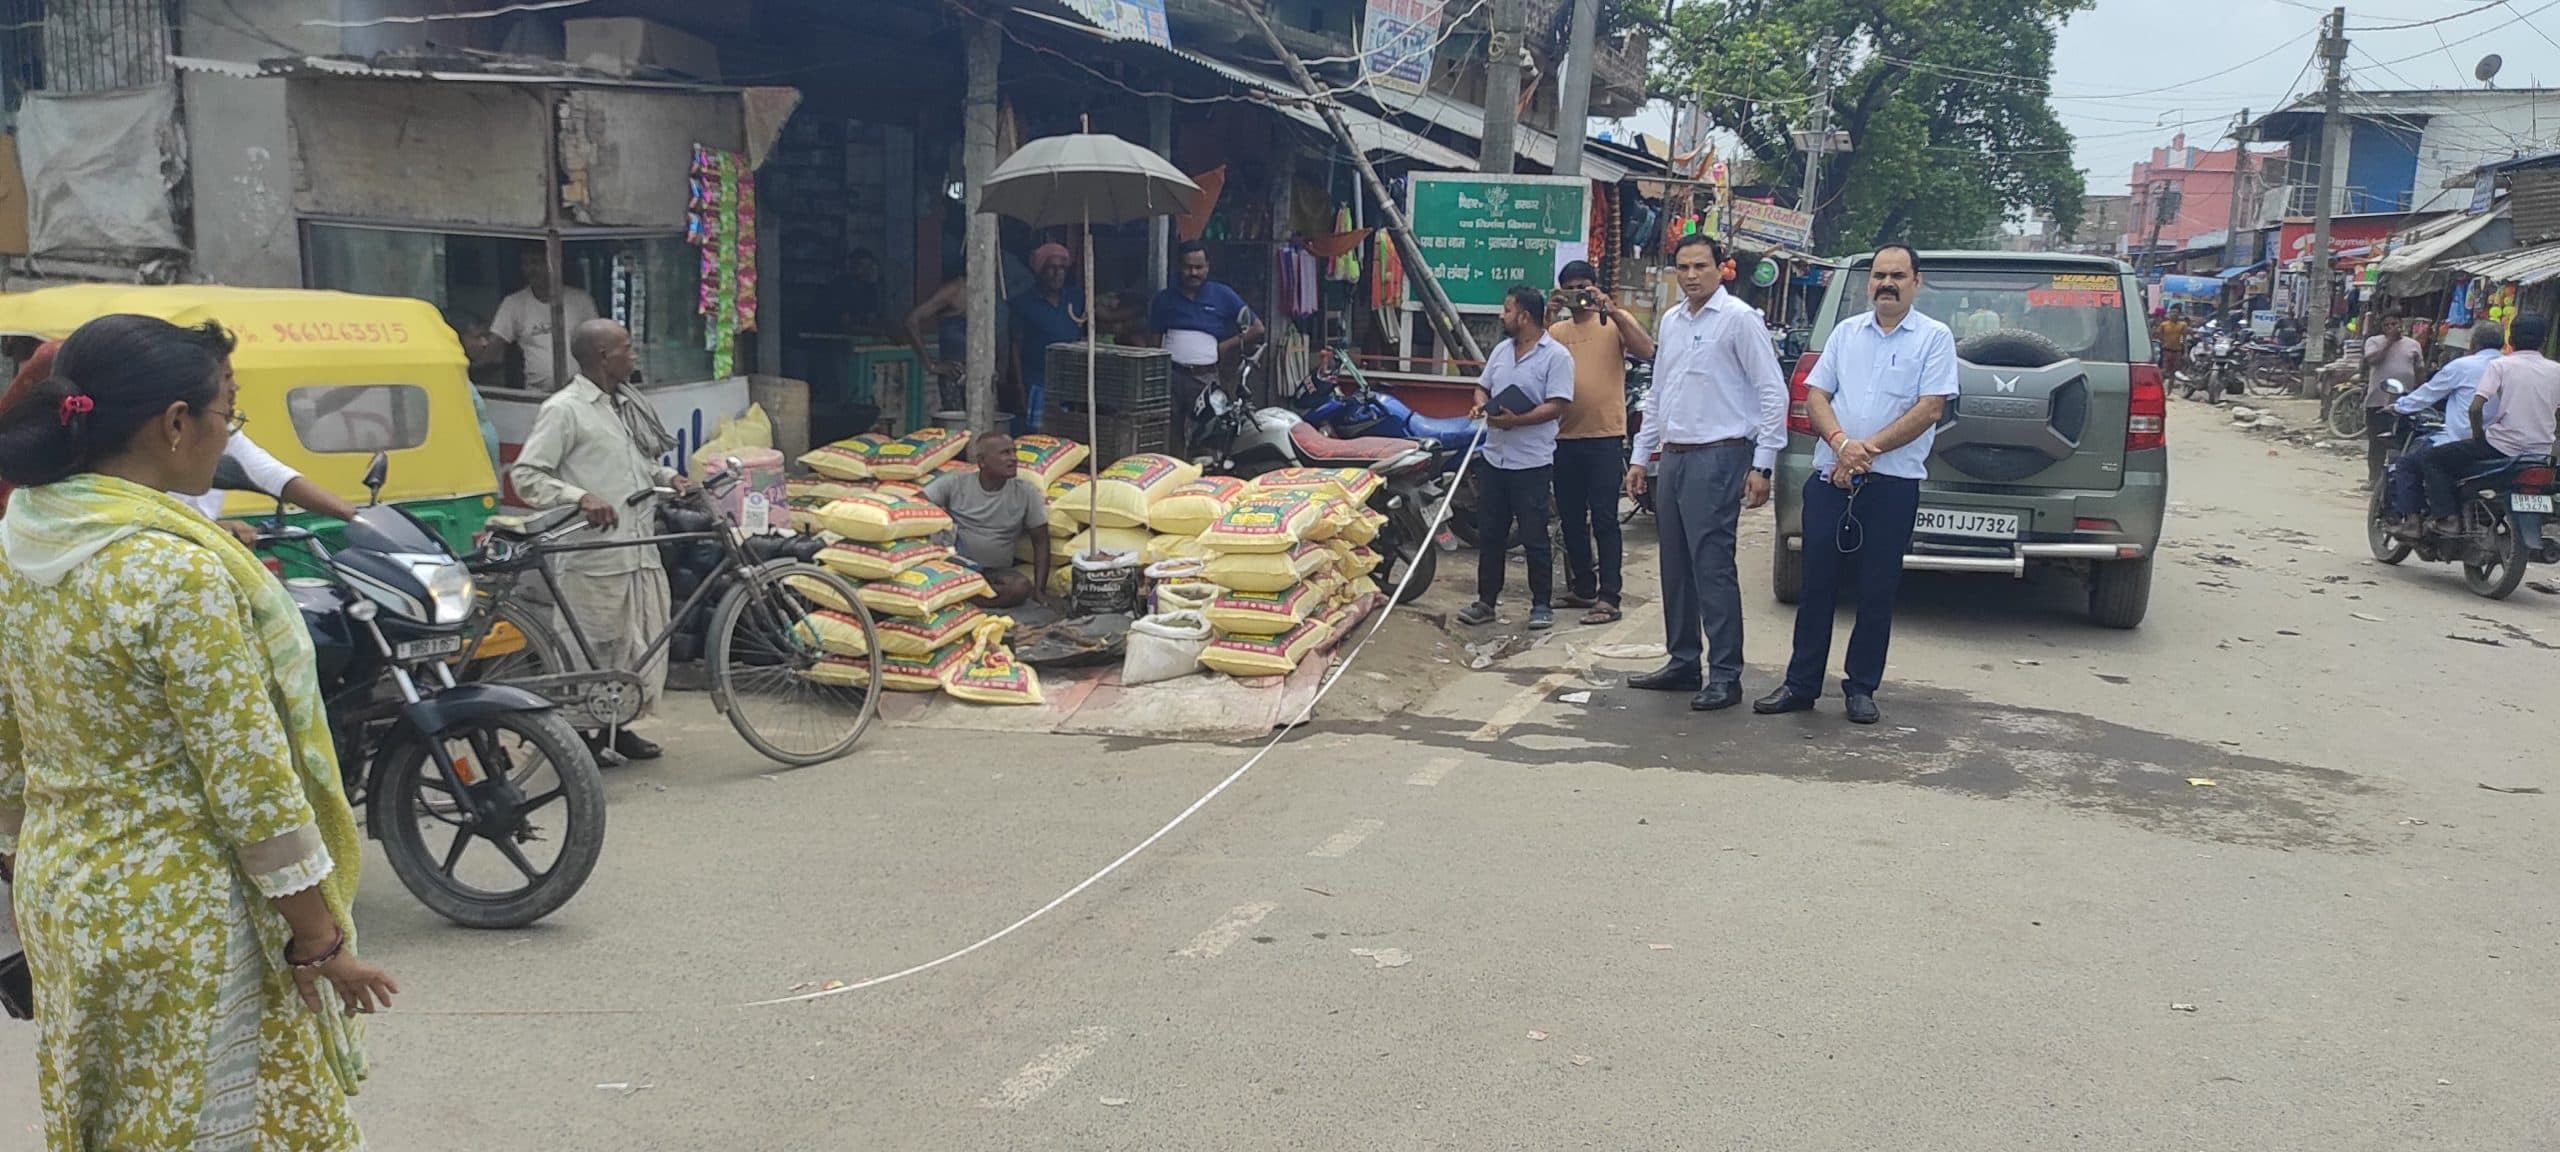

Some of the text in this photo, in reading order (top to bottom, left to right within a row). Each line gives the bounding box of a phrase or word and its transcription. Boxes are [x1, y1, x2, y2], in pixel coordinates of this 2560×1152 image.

[1420, 236, 1434, 249] पथ
[1434, 236, 1447, 249] का
[1448, 236, 1466, 249] नाम
[1510, 268, 1525, 281] KM
[1916, 512, 2016, 534] BR01JJ7324
